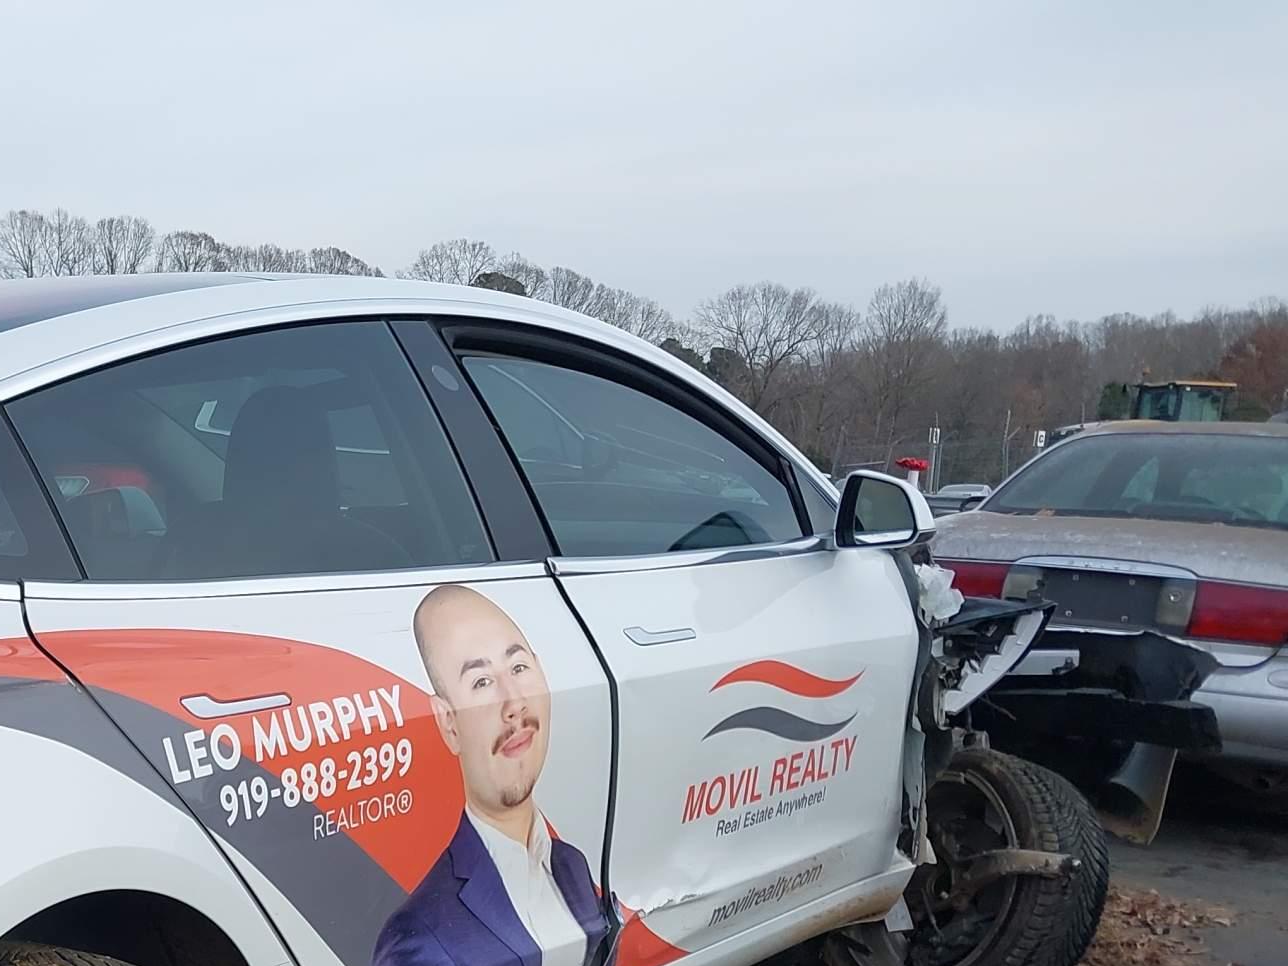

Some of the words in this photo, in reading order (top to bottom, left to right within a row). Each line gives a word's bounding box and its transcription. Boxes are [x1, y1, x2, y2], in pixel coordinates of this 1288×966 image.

[162, 723, 242, 785] LEO
[252, 684, 404, 763] MURPHY
[219, 737, 413, 827] 919-888-2399
[313, 789, 413, 841] REALTOR®
[681, 765, 762, 825] MOVIL
[769, 735, 858, 797] REALTY
[715, 815, 742, 837] Real
[743, 806, 774, 829] Estate
[775, 786, 827, 817] Anywhere!
[707, 863, 823, 927] movilrealty.com
